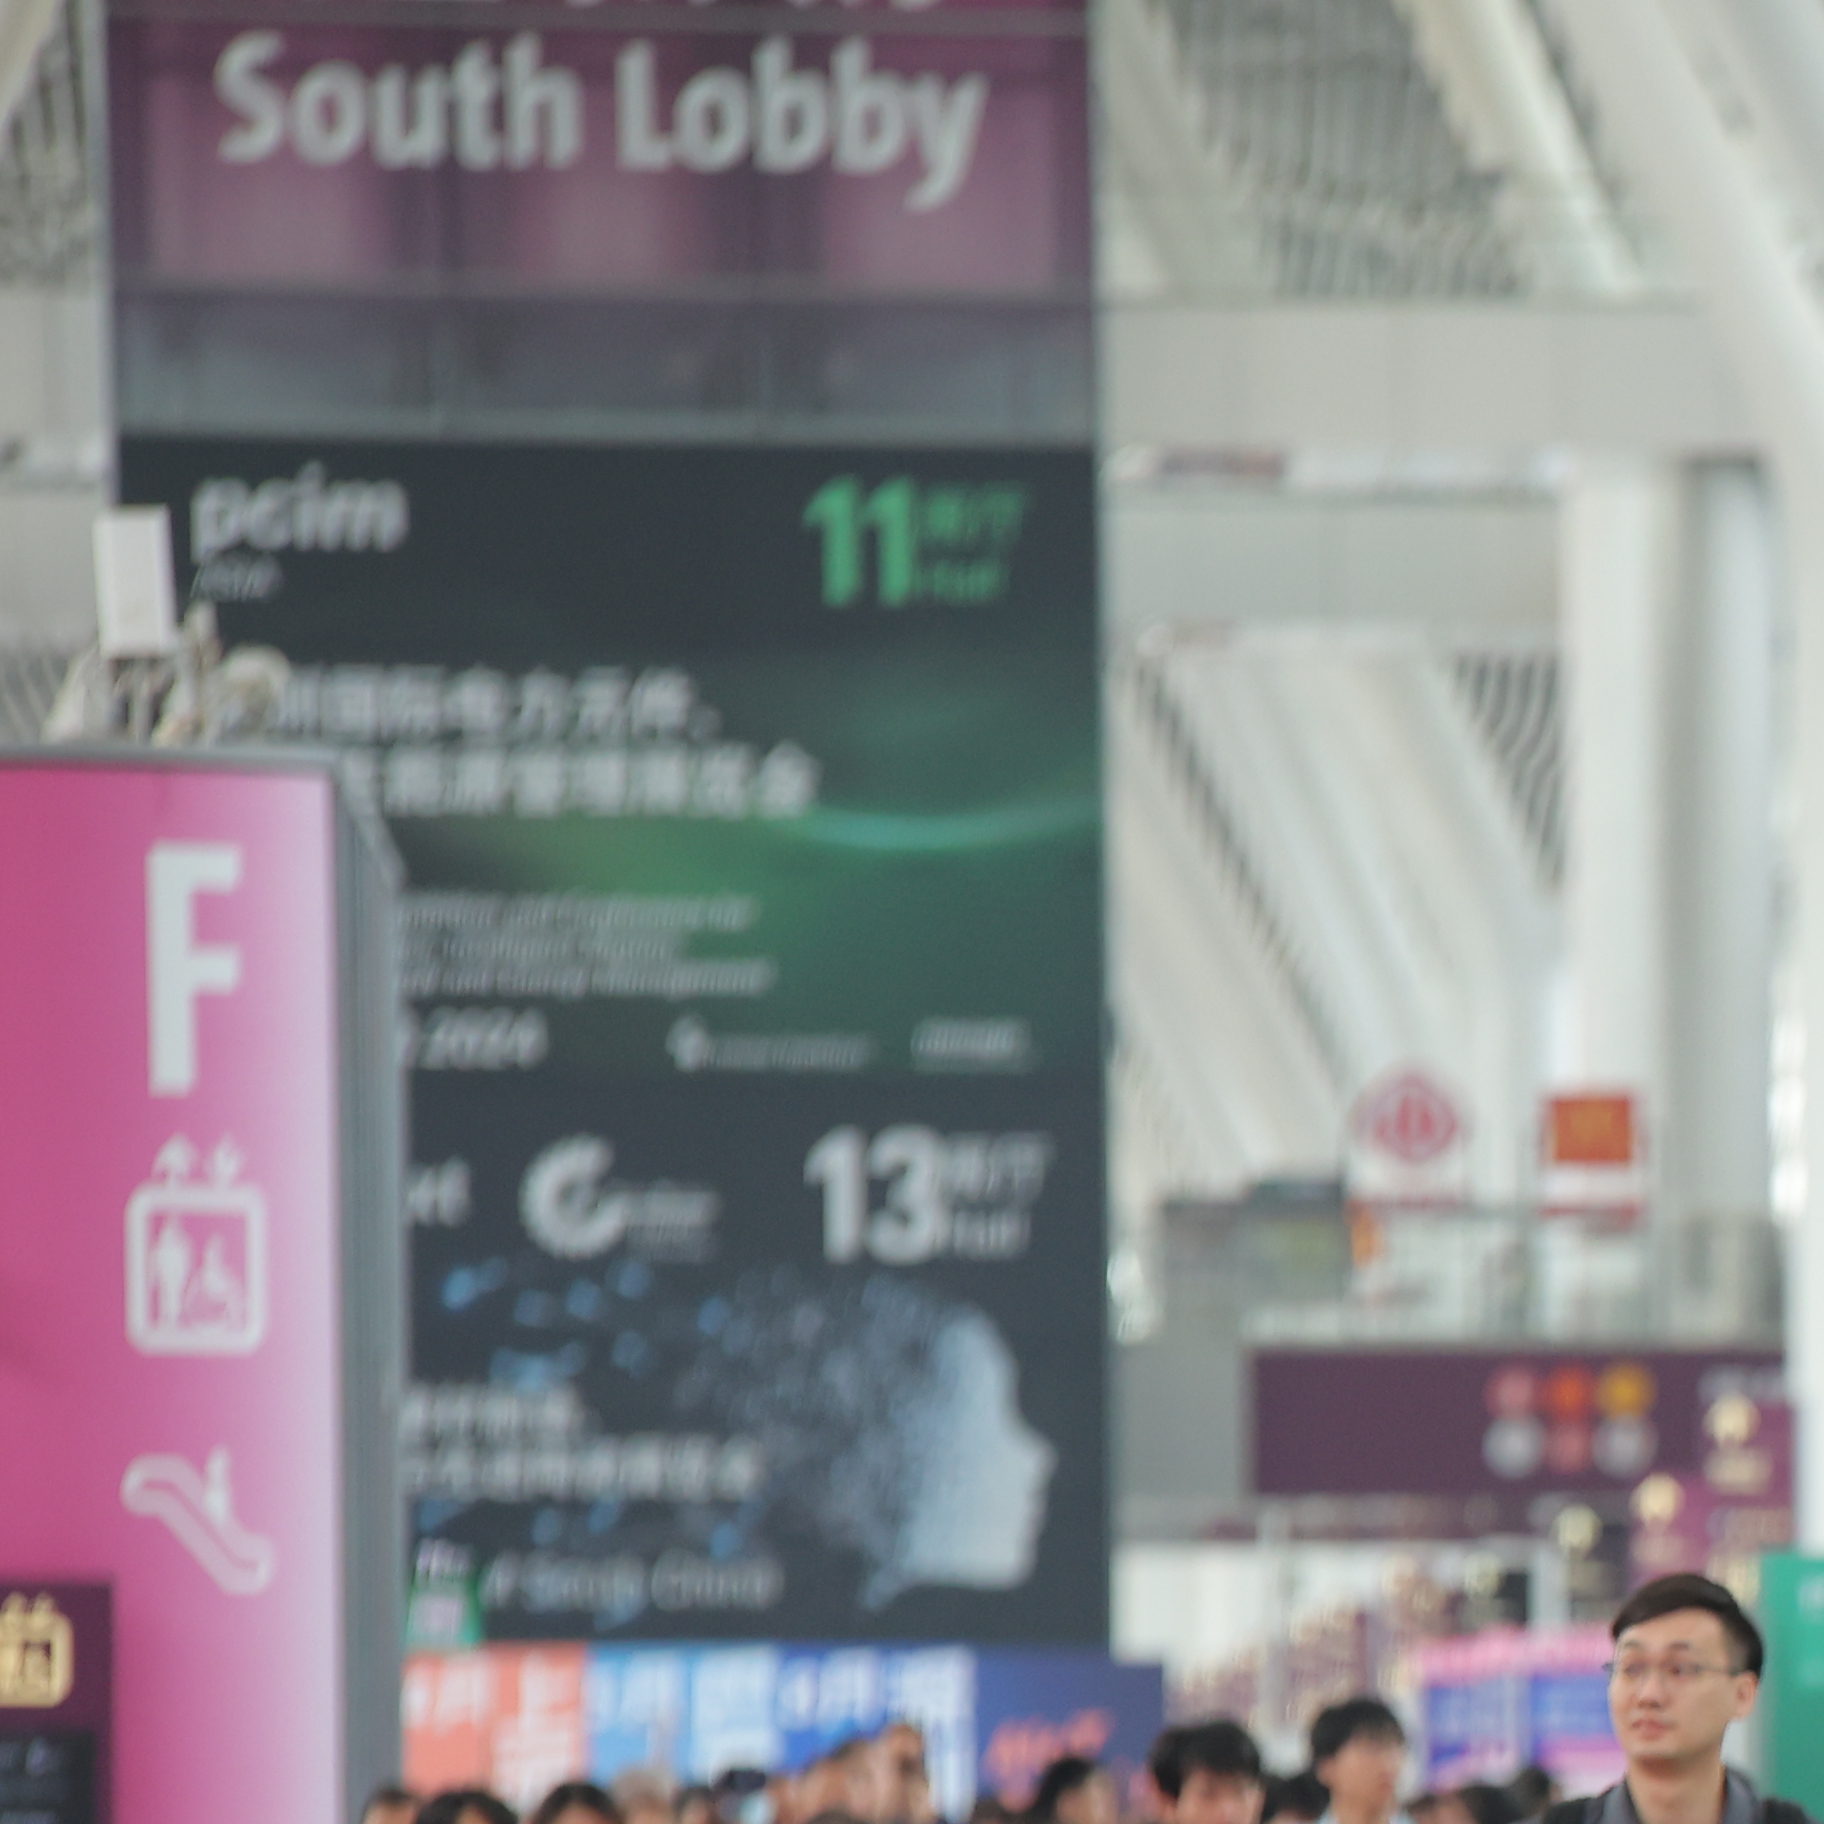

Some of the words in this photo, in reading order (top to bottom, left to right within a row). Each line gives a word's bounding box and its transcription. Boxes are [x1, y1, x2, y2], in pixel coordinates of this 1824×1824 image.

[214, 29, 584, 170] South
[614, 36, 991, 211] Lobby
[146, 840, 242, 1096] F
[806, 1123, 946, 1265] 13
